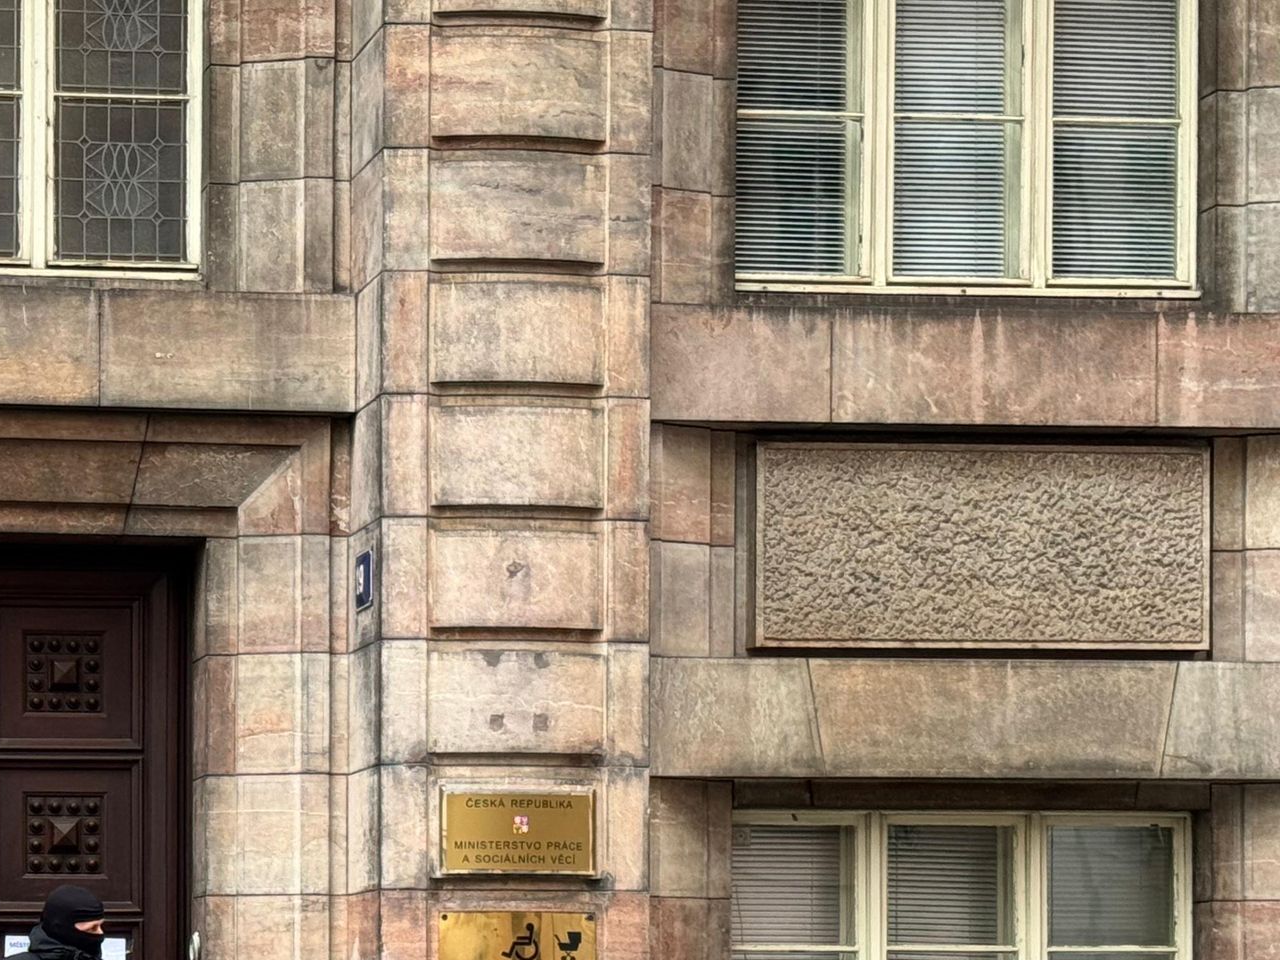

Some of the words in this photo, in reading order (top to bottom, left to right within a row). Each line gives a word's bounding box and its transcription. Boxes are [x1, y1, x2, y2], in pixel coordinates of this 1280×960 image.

[465, 797, 506, 809] ČESKÁ
[510, 798, 574, 809] REPUBLIKA
[454, 840, 542, 850] MINISTERSTVO
[546, 839, 583, 851] PRÁCE
[461, 854, 471, 864] A
[475, 852, 546, 864] SOCIÁLNÍCH
[550, 852, 577, 865] VĚCÍ
